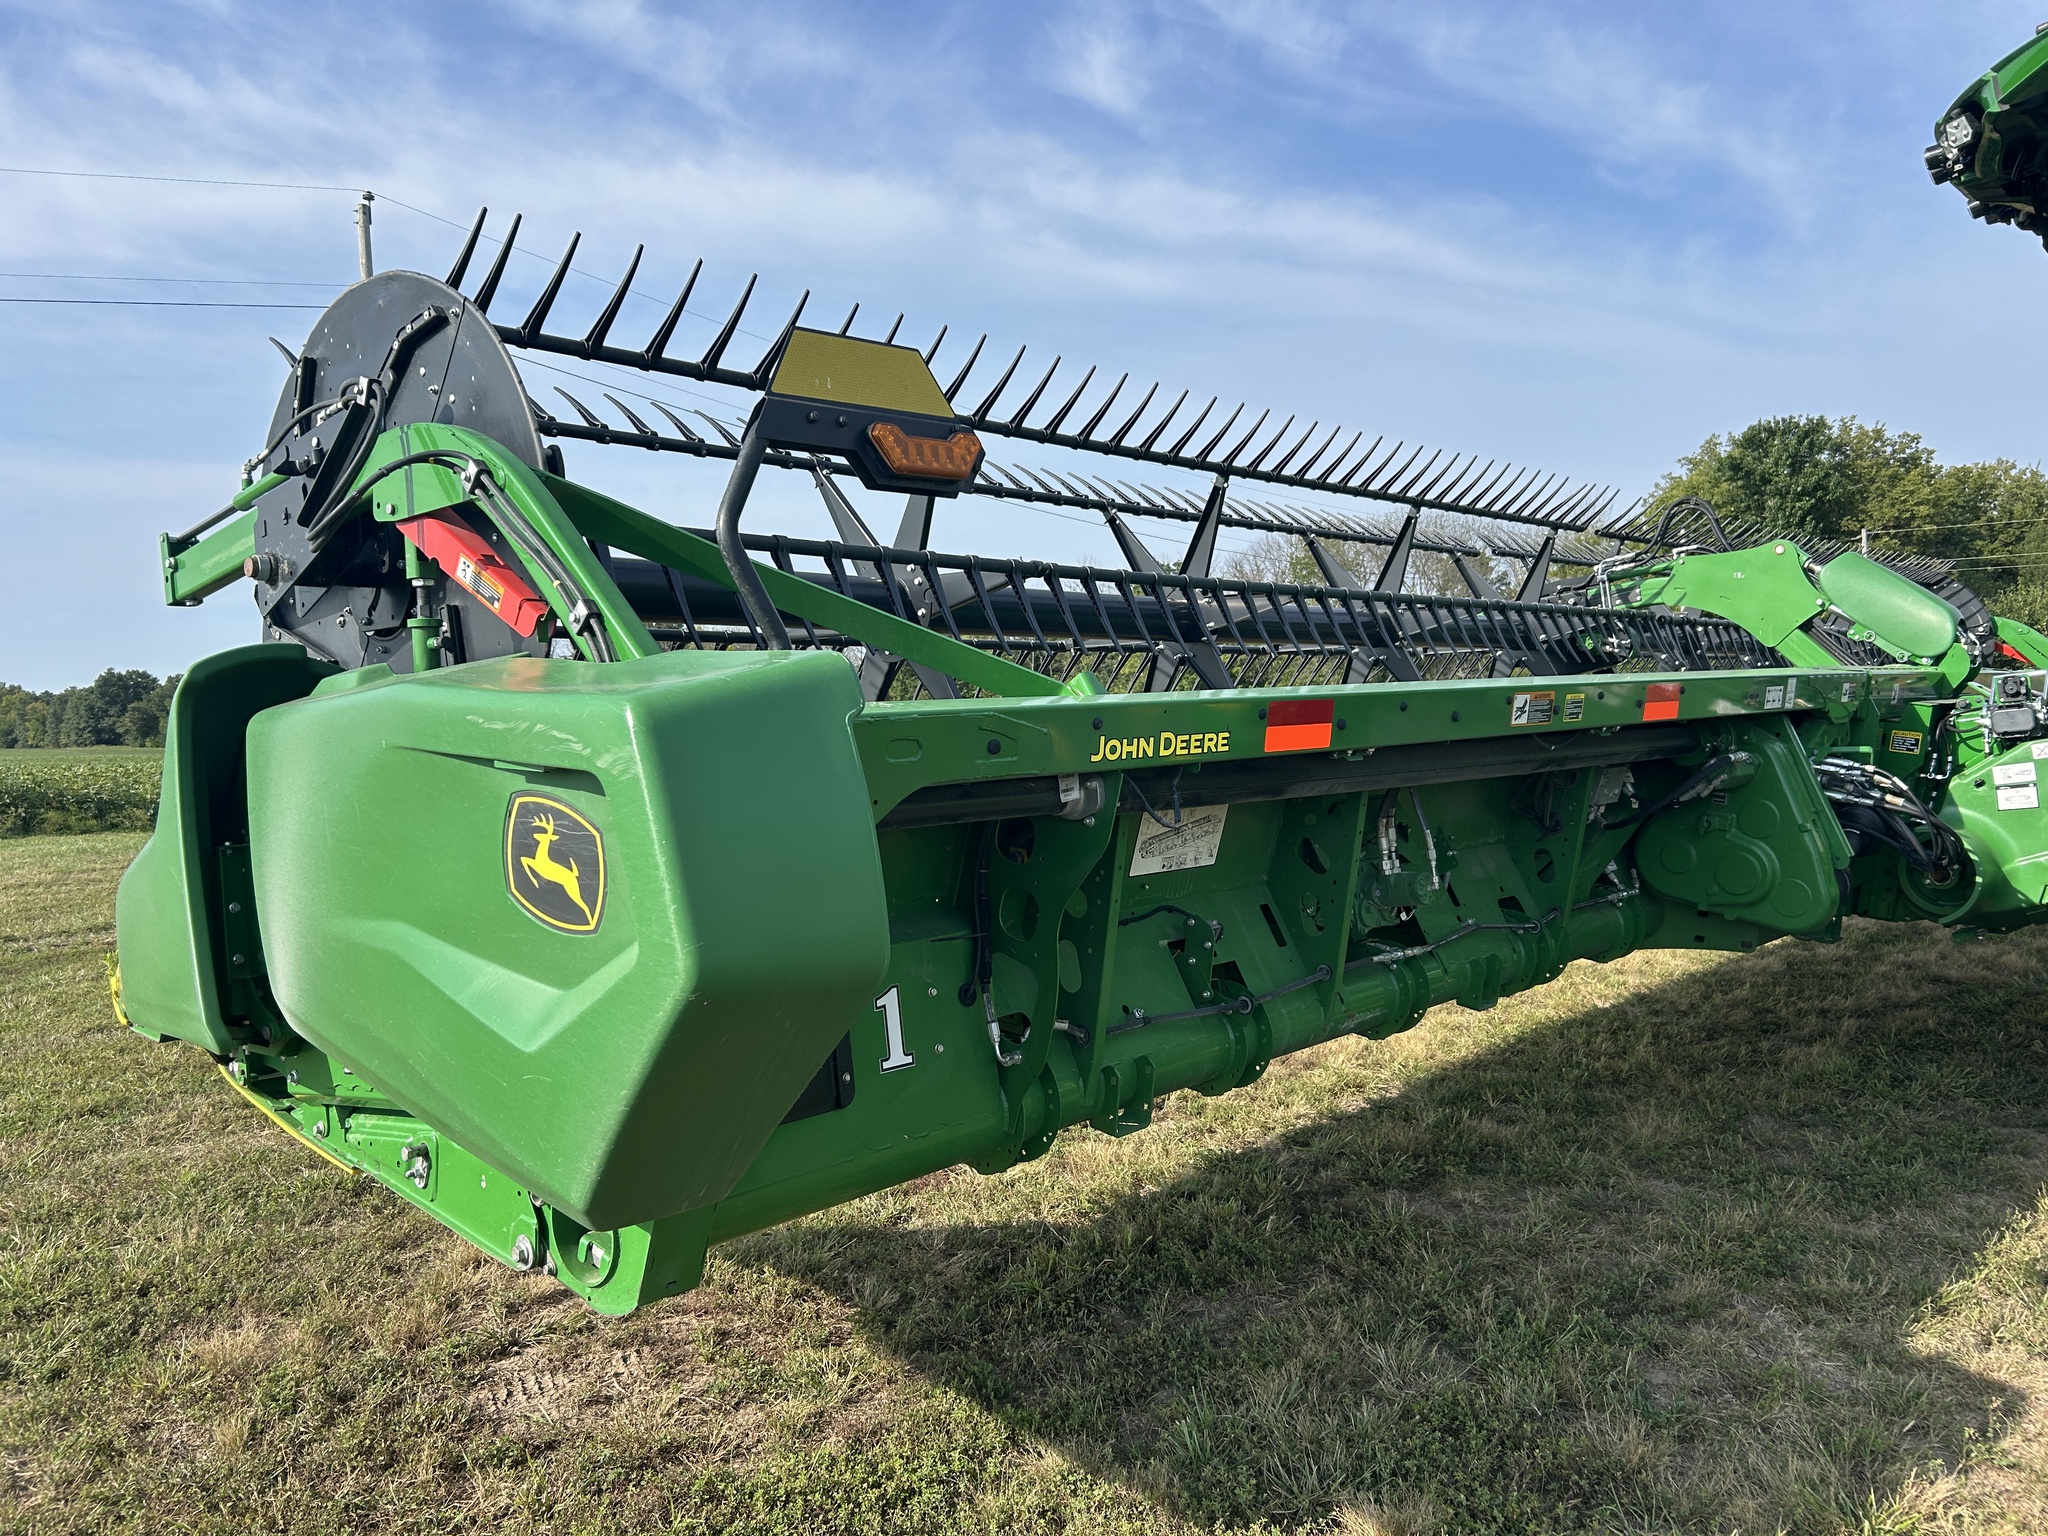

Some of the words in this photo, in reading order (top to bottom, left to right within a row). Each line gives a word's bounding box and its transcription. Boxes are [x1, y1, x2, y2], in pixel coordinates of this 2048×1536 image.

[1090, 735, 1154, 763] JOHN
[1159, 731, 1231, 757] DEERE
[873, 983, 916, 1074] 1
